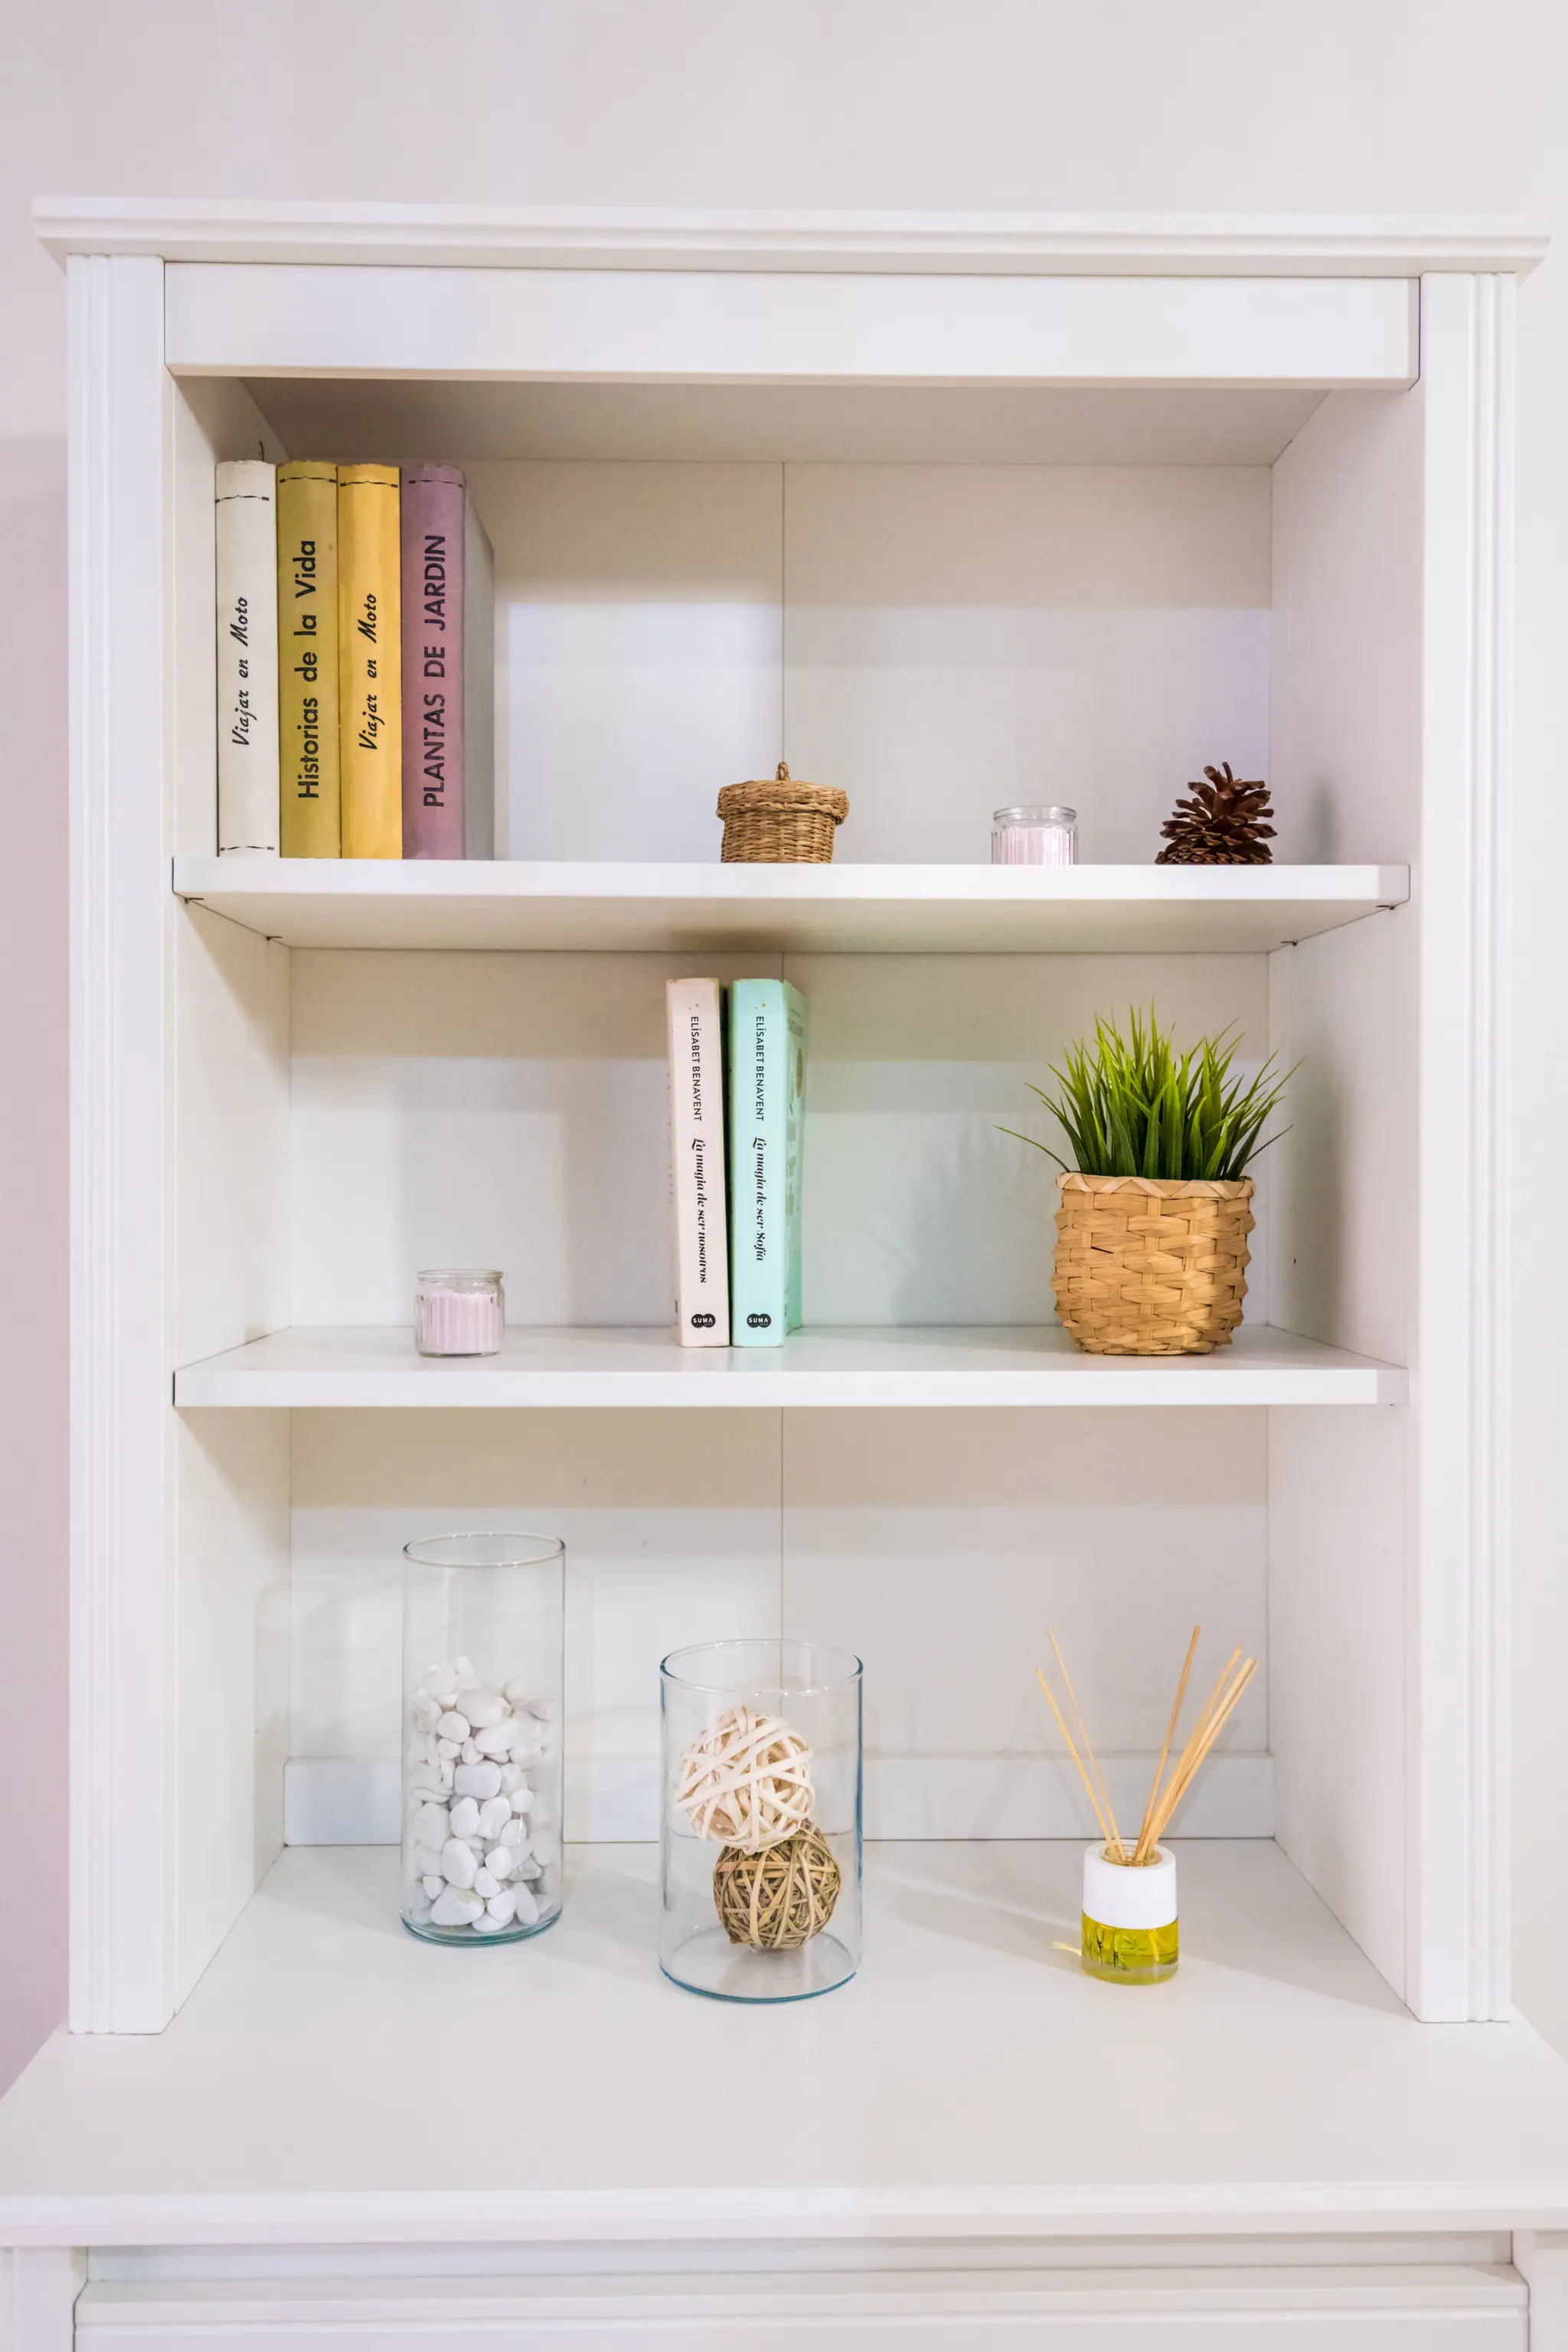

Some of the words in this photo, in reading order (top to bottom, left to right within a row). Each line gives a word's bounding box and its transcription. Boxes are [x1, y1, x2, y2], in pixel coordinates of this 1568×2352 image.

[292, 540, 316, 599] Vida
[423, 535, 446, 632] JARDIN
[229, 596, 249, 647] Moto
[293, 614, 317, 636] la
[356, 593, 377, 644] Moto
[237, 659, 250, 679] en
[293, 651, 318, 683] de
[366, 658, 378, 679] en
[423, 645, 446, 678] DE
[231, 689, 259, 748] Viajar
[358, 694, 386, 751] Viajar
[296, 697, 319, 799] Historias
[423, 693, 446, 808] PLANTAS
[691, 1016, 701, 1063] ELÍSABET
[756, 1016, 767, 1063] ELÍSABET
[692, 1066, 702, 1122] BENAVENT
[756, 1066, 765, 1122] BENAVENT
[691, 1138, 707, 1152] La
[753, 1136, 767, 1150] La
[694, 1153, 707, 1191] magia
[754, 1151, 766, 1190] magia
[697, 1192, 707, 1207] de
[697, 1209, 706, 1231] ser
[756, 1191, 767, 1207] de
[756, 1207, 765, 1230] ser
[697, 1231, 707, 1283] nosotros
